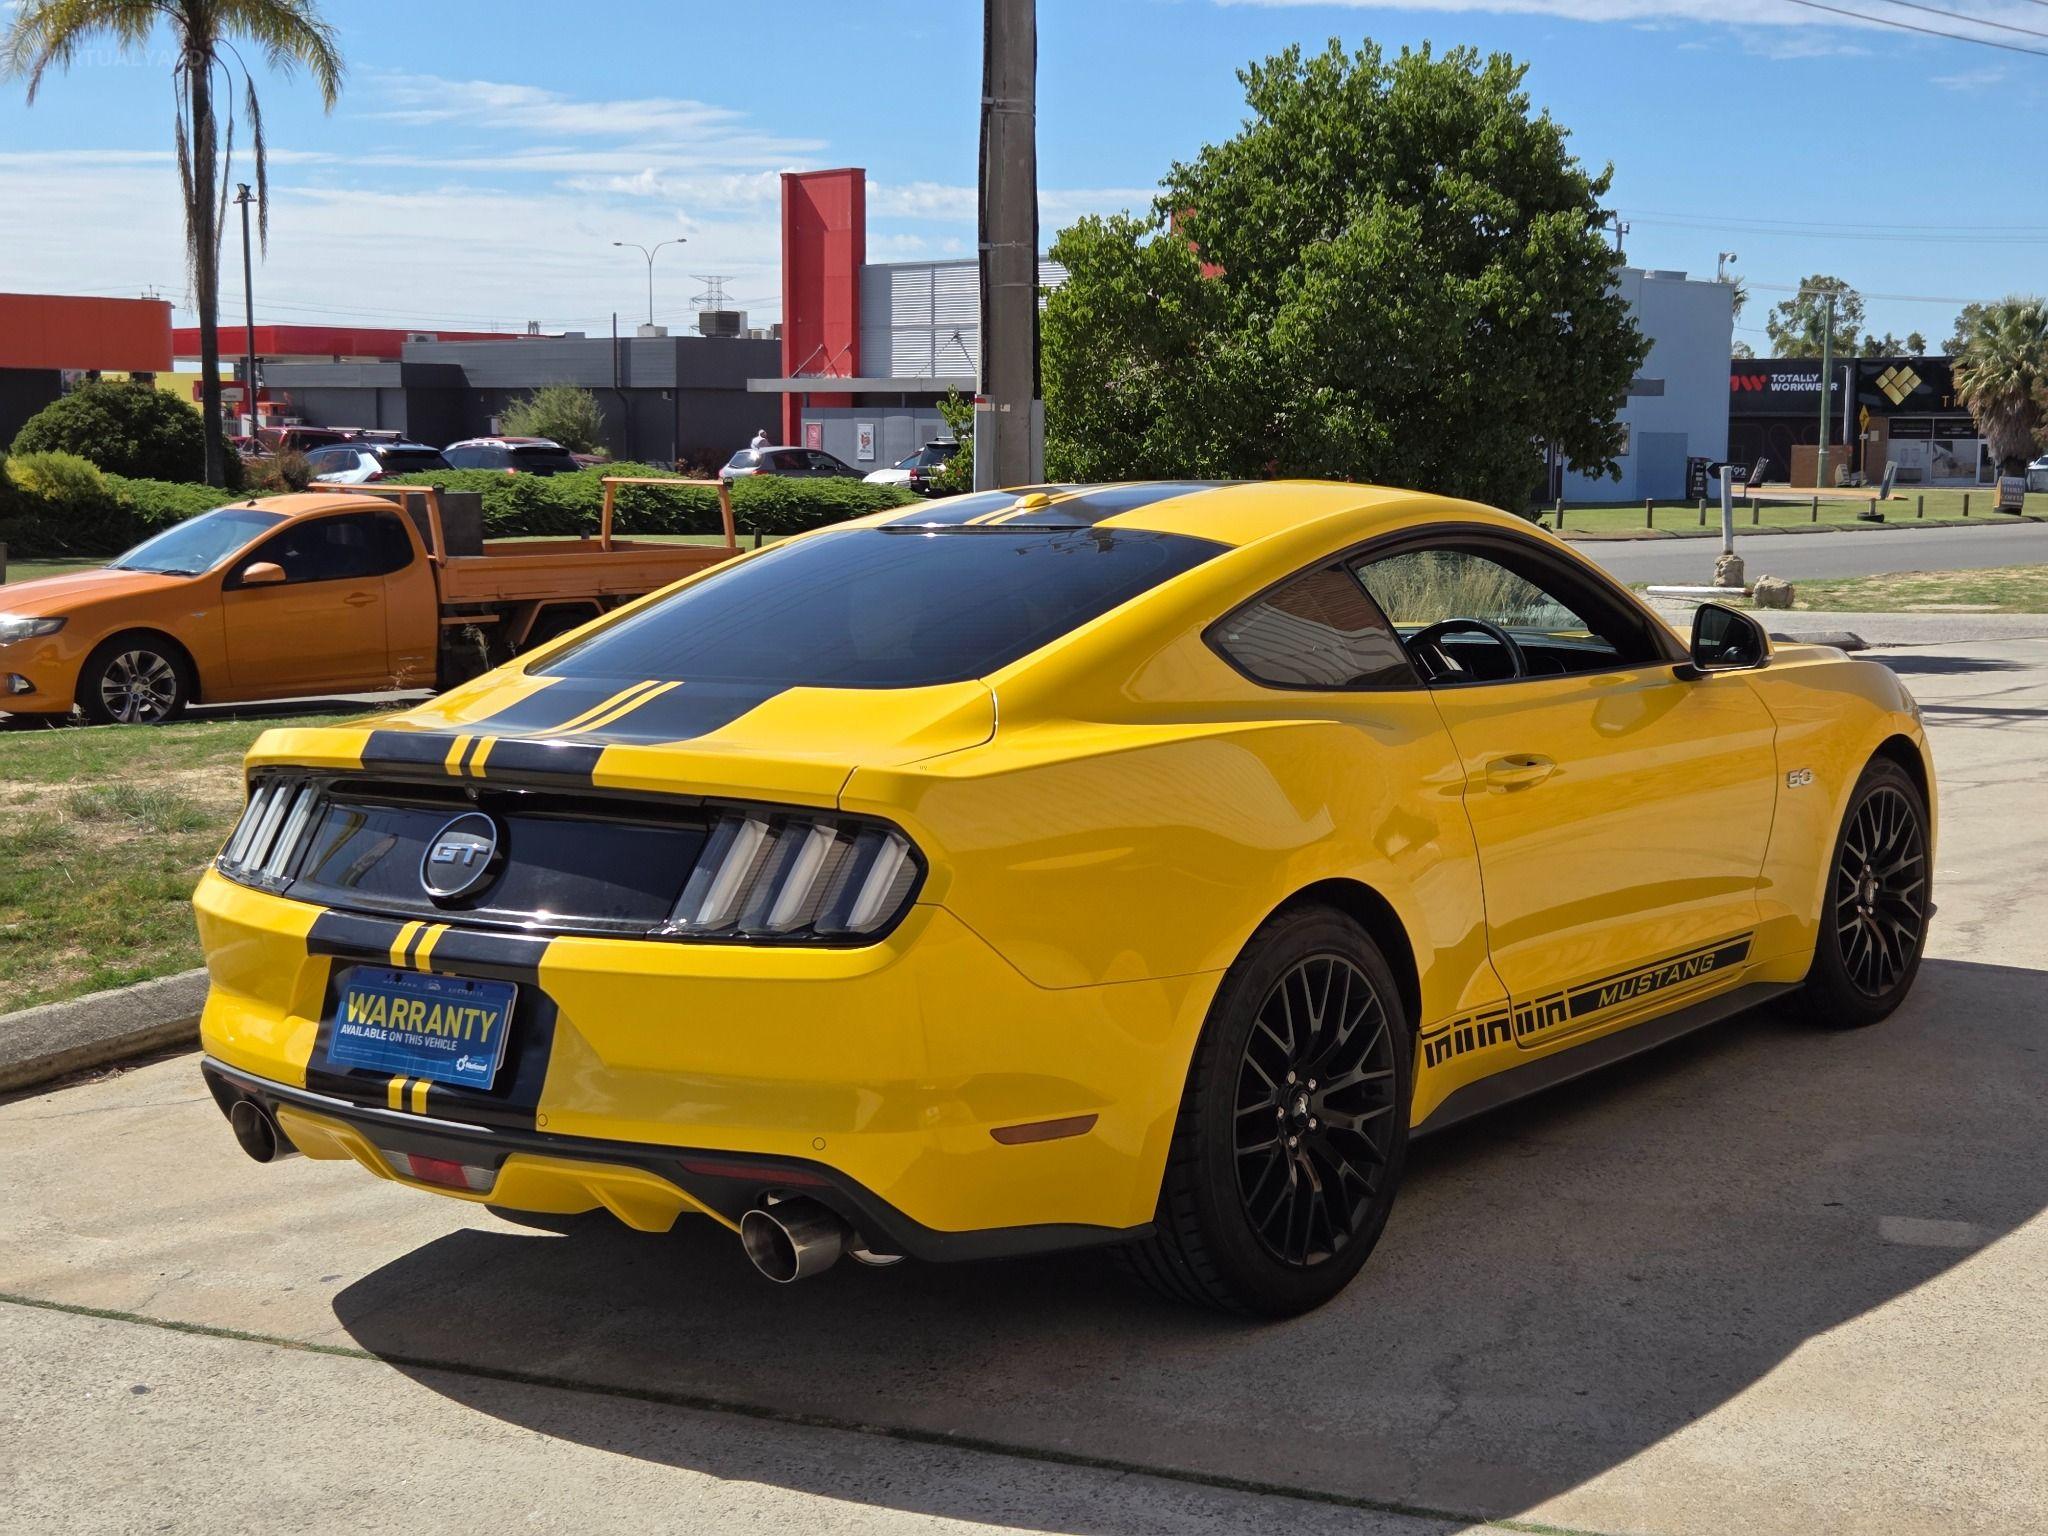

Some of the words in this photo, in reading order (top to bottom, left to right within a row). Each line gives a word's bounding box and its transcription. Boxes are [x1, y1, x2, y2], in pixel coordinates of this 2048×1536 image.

[1771, 374, 1819, 383] TOTALLY
[1771, 383, 1838, 391] WORKWER
[431, 842, 489, 867] GT
[1598, 953, 1715, 1008] MUSTANG
[347, 992, 498, 1043] WARRANTY
[340, 1024, 387, 1041] AVAILABLE
[389, 1032, 402, 1043] ON
[404, 1033, 423, 1046] THIS
[425, 1036, 457, 1051] VEHICLE
